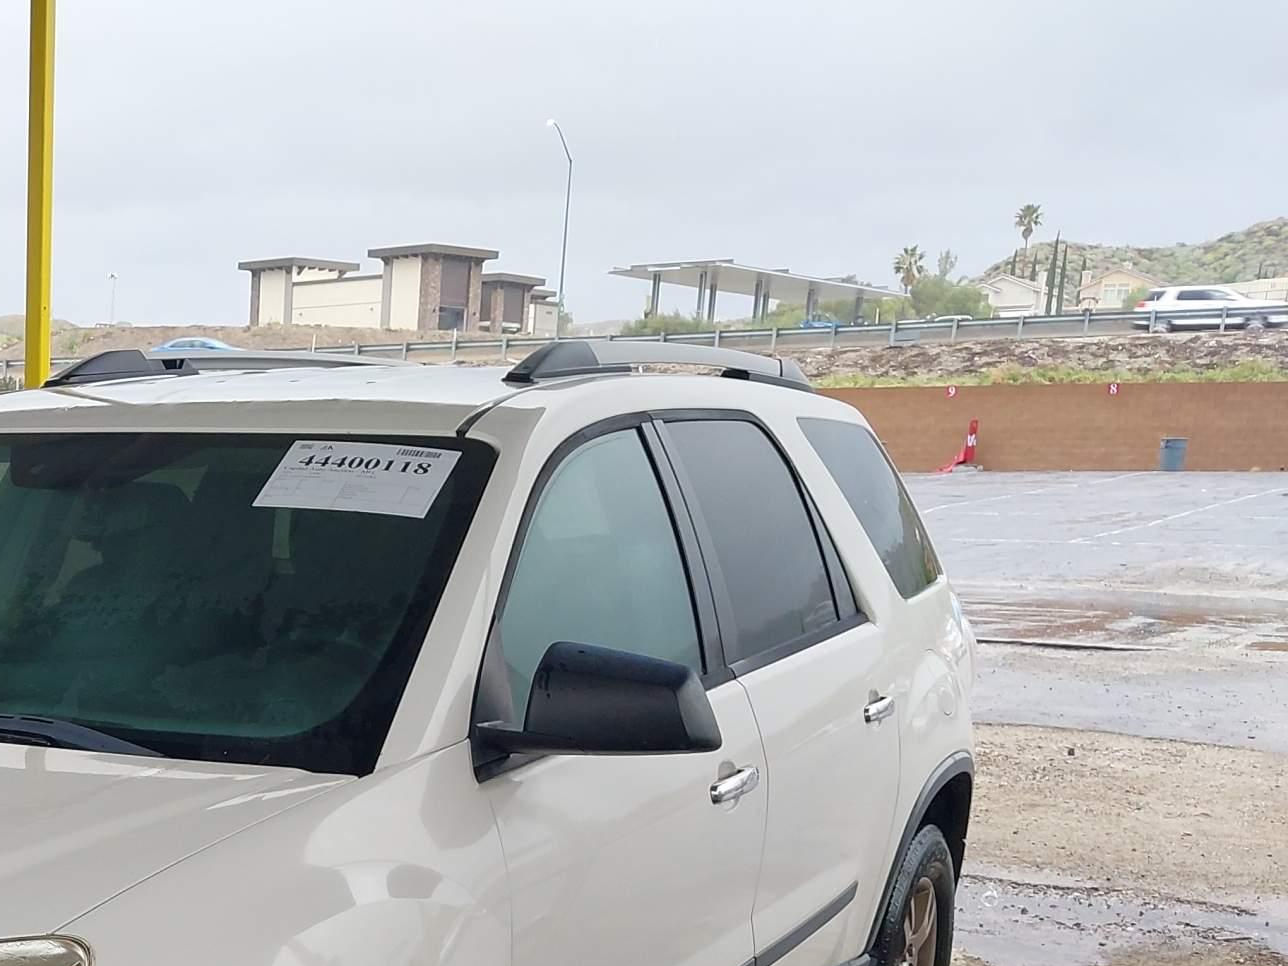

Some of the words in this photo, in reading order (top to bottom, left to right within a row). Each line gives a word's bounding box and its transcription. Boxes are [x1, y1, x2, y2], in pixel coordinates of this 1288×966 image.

[948, 386, 956, 397] 9
[1110, 383, 1118, 395] 8
[298, 454, 433, 476] 44400118
